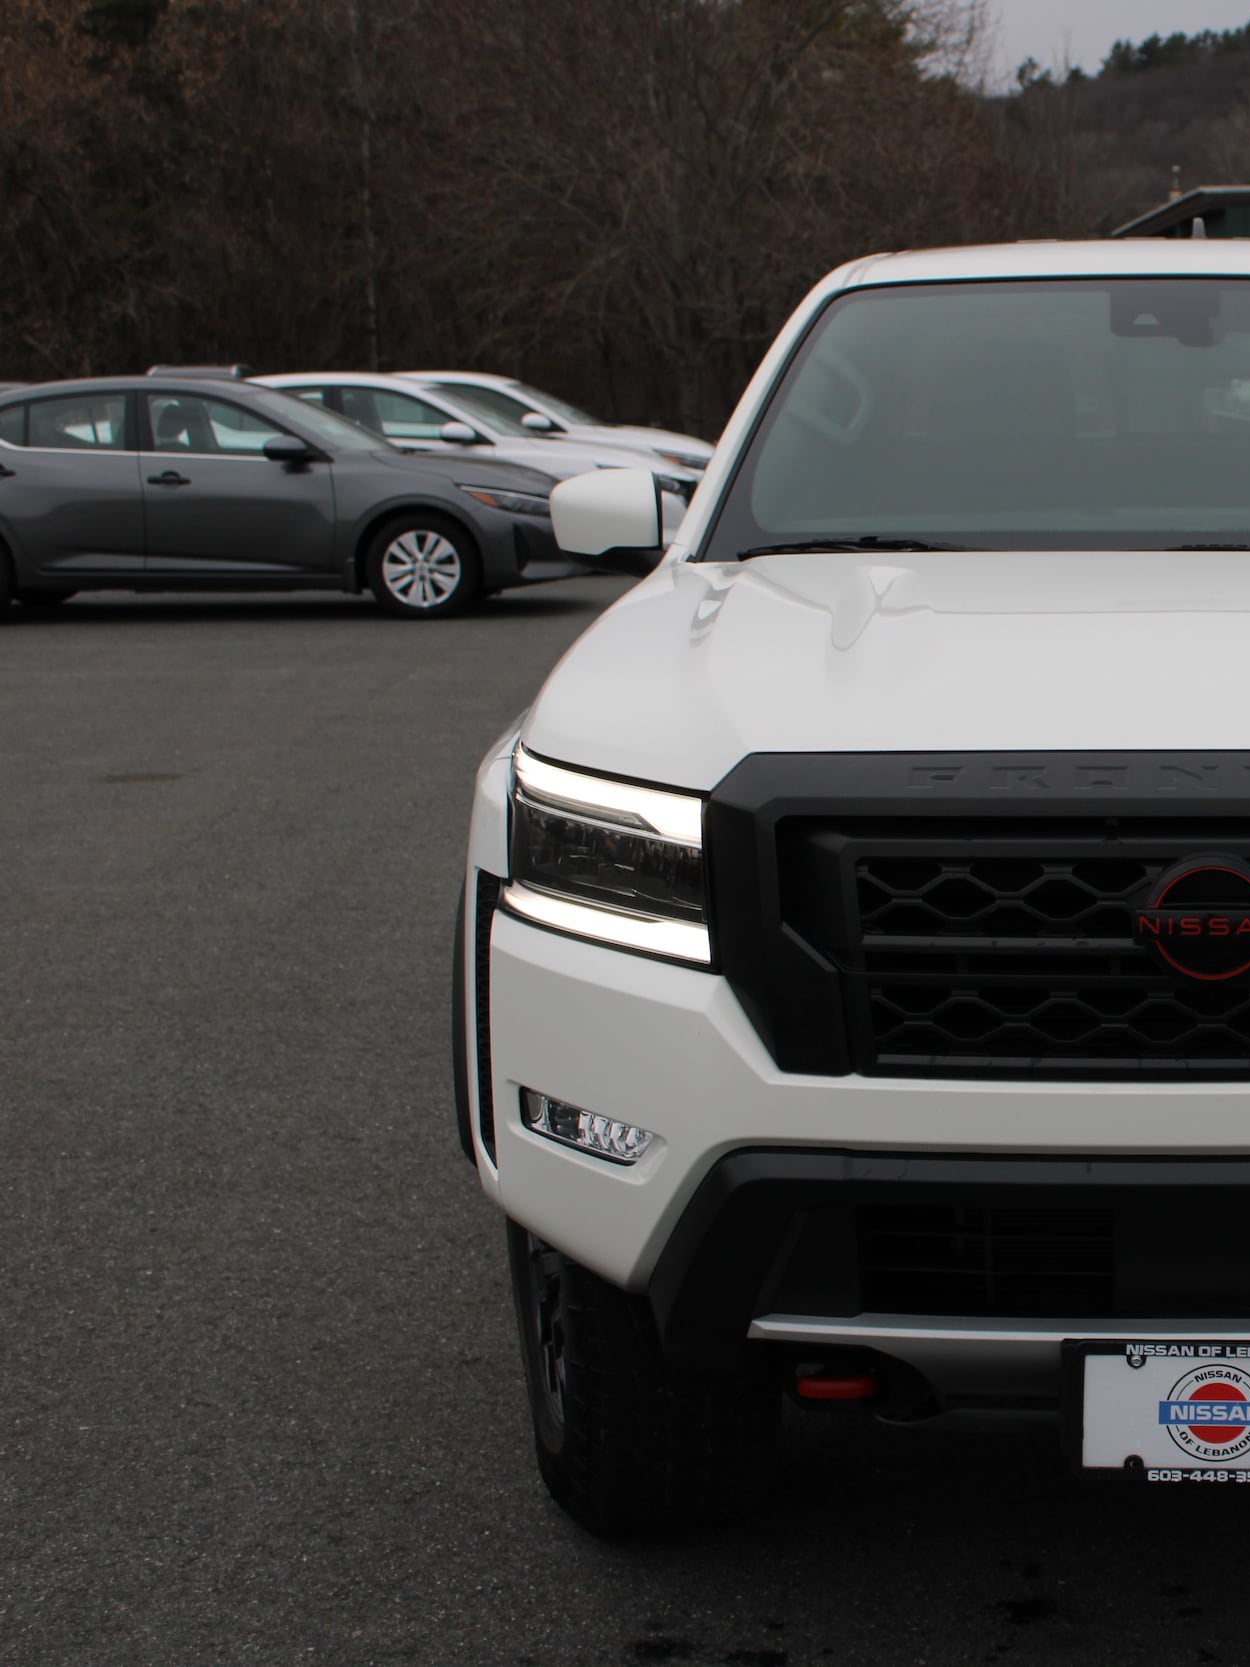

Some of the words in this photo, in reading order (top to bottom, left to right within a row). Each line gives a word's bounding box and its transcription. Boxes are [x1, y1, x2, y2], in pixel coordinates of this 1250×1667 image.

[1126, 1343, 1195, 1357] NISSAN
[1198, 1345, 1224, 1358] OF
[1194, 1370, 1243, 1384] NISSAN
[1179, 1430, 1194, 1447] OF
